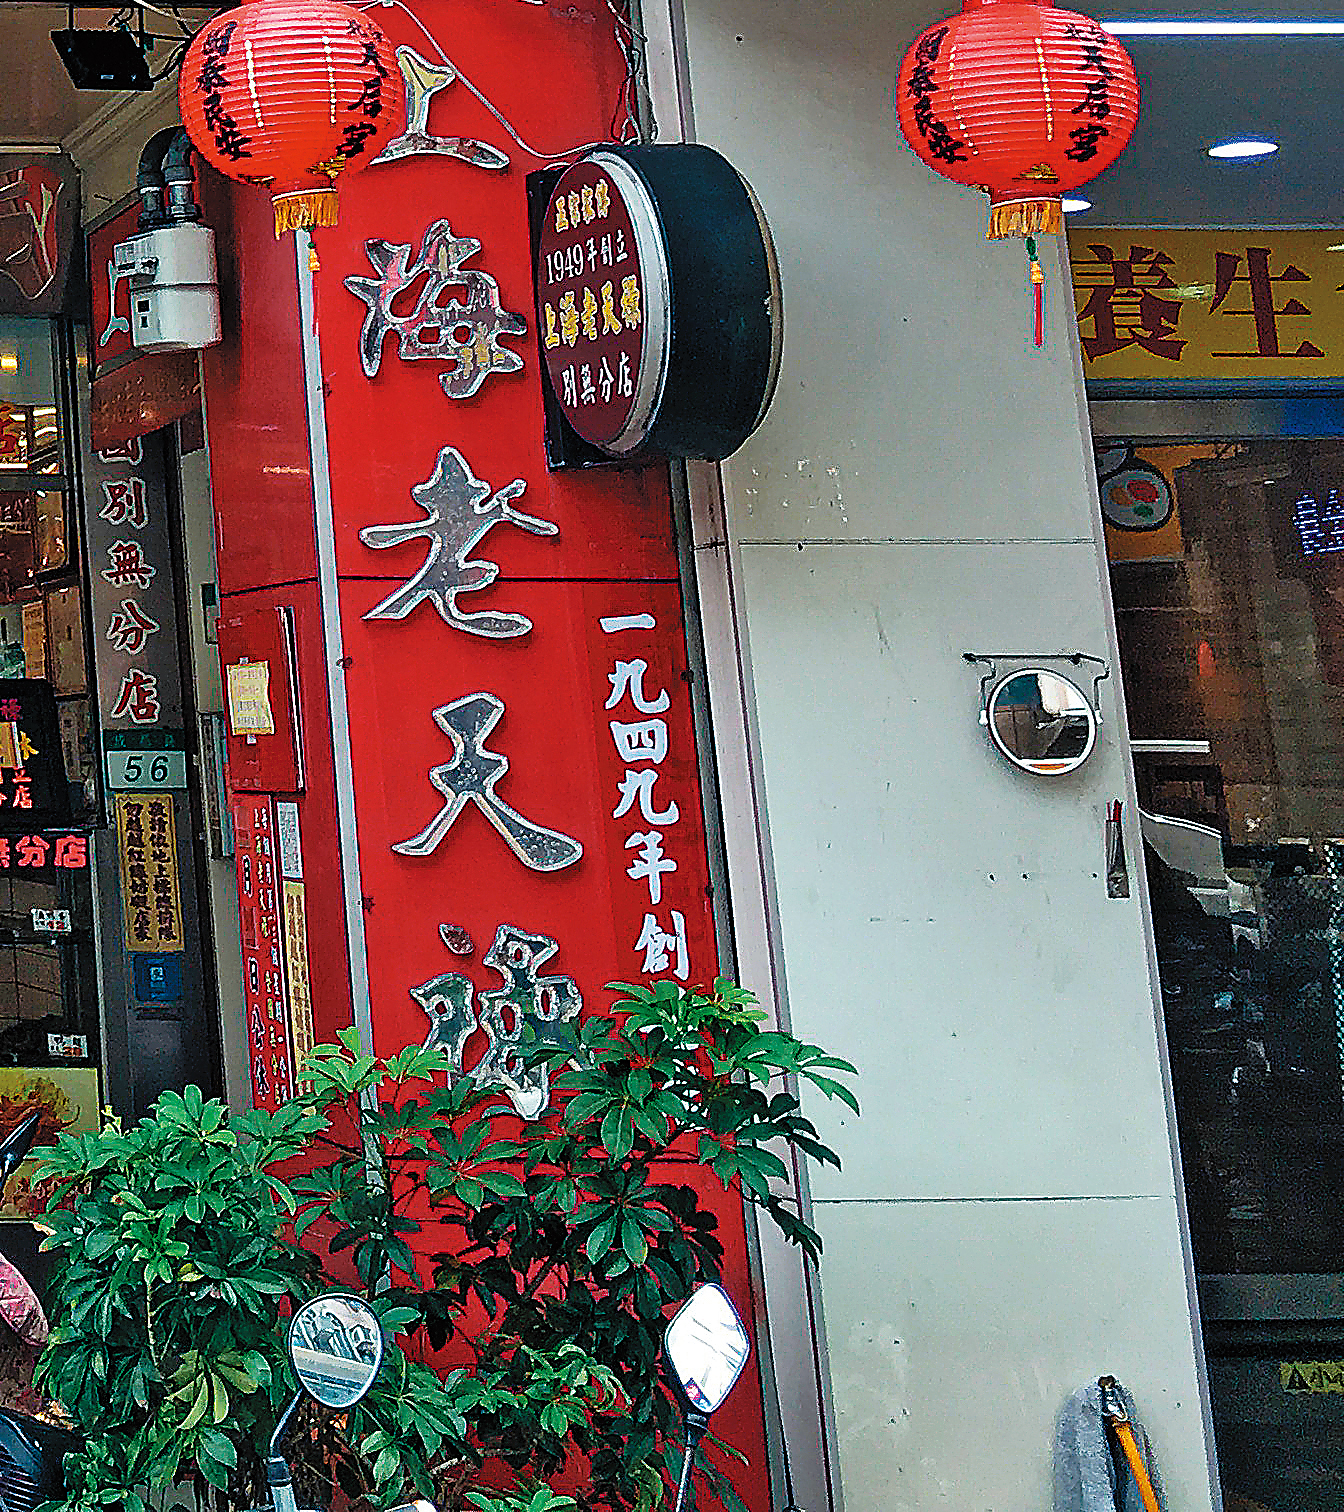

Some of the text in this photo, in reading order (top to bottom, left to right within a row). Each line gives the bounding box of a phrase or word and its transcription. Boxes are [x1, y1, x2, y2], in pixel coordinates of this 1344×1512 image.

[1072, 244, 1344, 364] 養生
[123, 755, 169, 784] 56
[599, 611, 694, 1048] 一九四九年創
